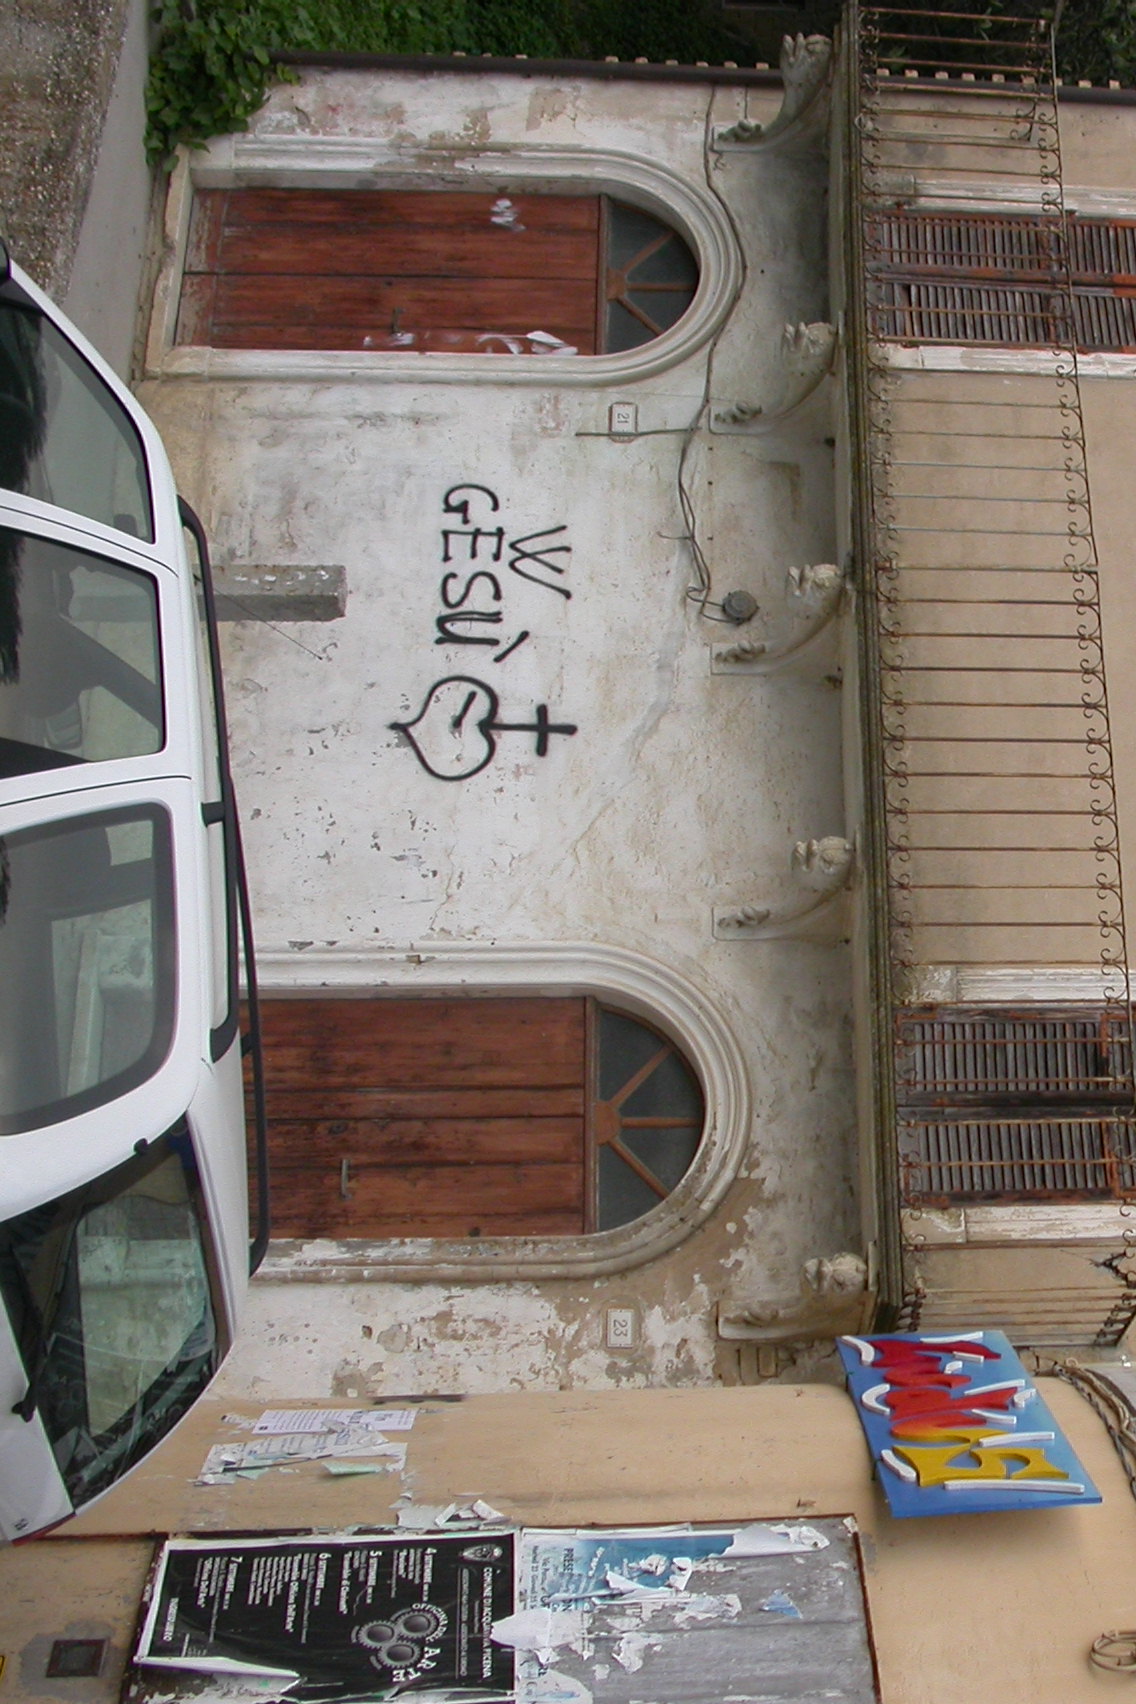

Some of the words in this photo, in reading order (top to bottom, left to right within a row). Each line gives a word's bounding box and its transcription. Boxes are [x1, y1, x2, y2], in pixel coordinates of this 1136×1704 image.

[617, 412, 630, 424] 21
[434, 484, 530, 663] GESÙ
[509, 525, 572, 600] W
[613, 1319, 628, 1337] 23
[483, 1567, 493, 1597] COMUNE
[412, 1603, 449, 1626] OFFICINA
[482, 1648, 491, 1679] PICENA
